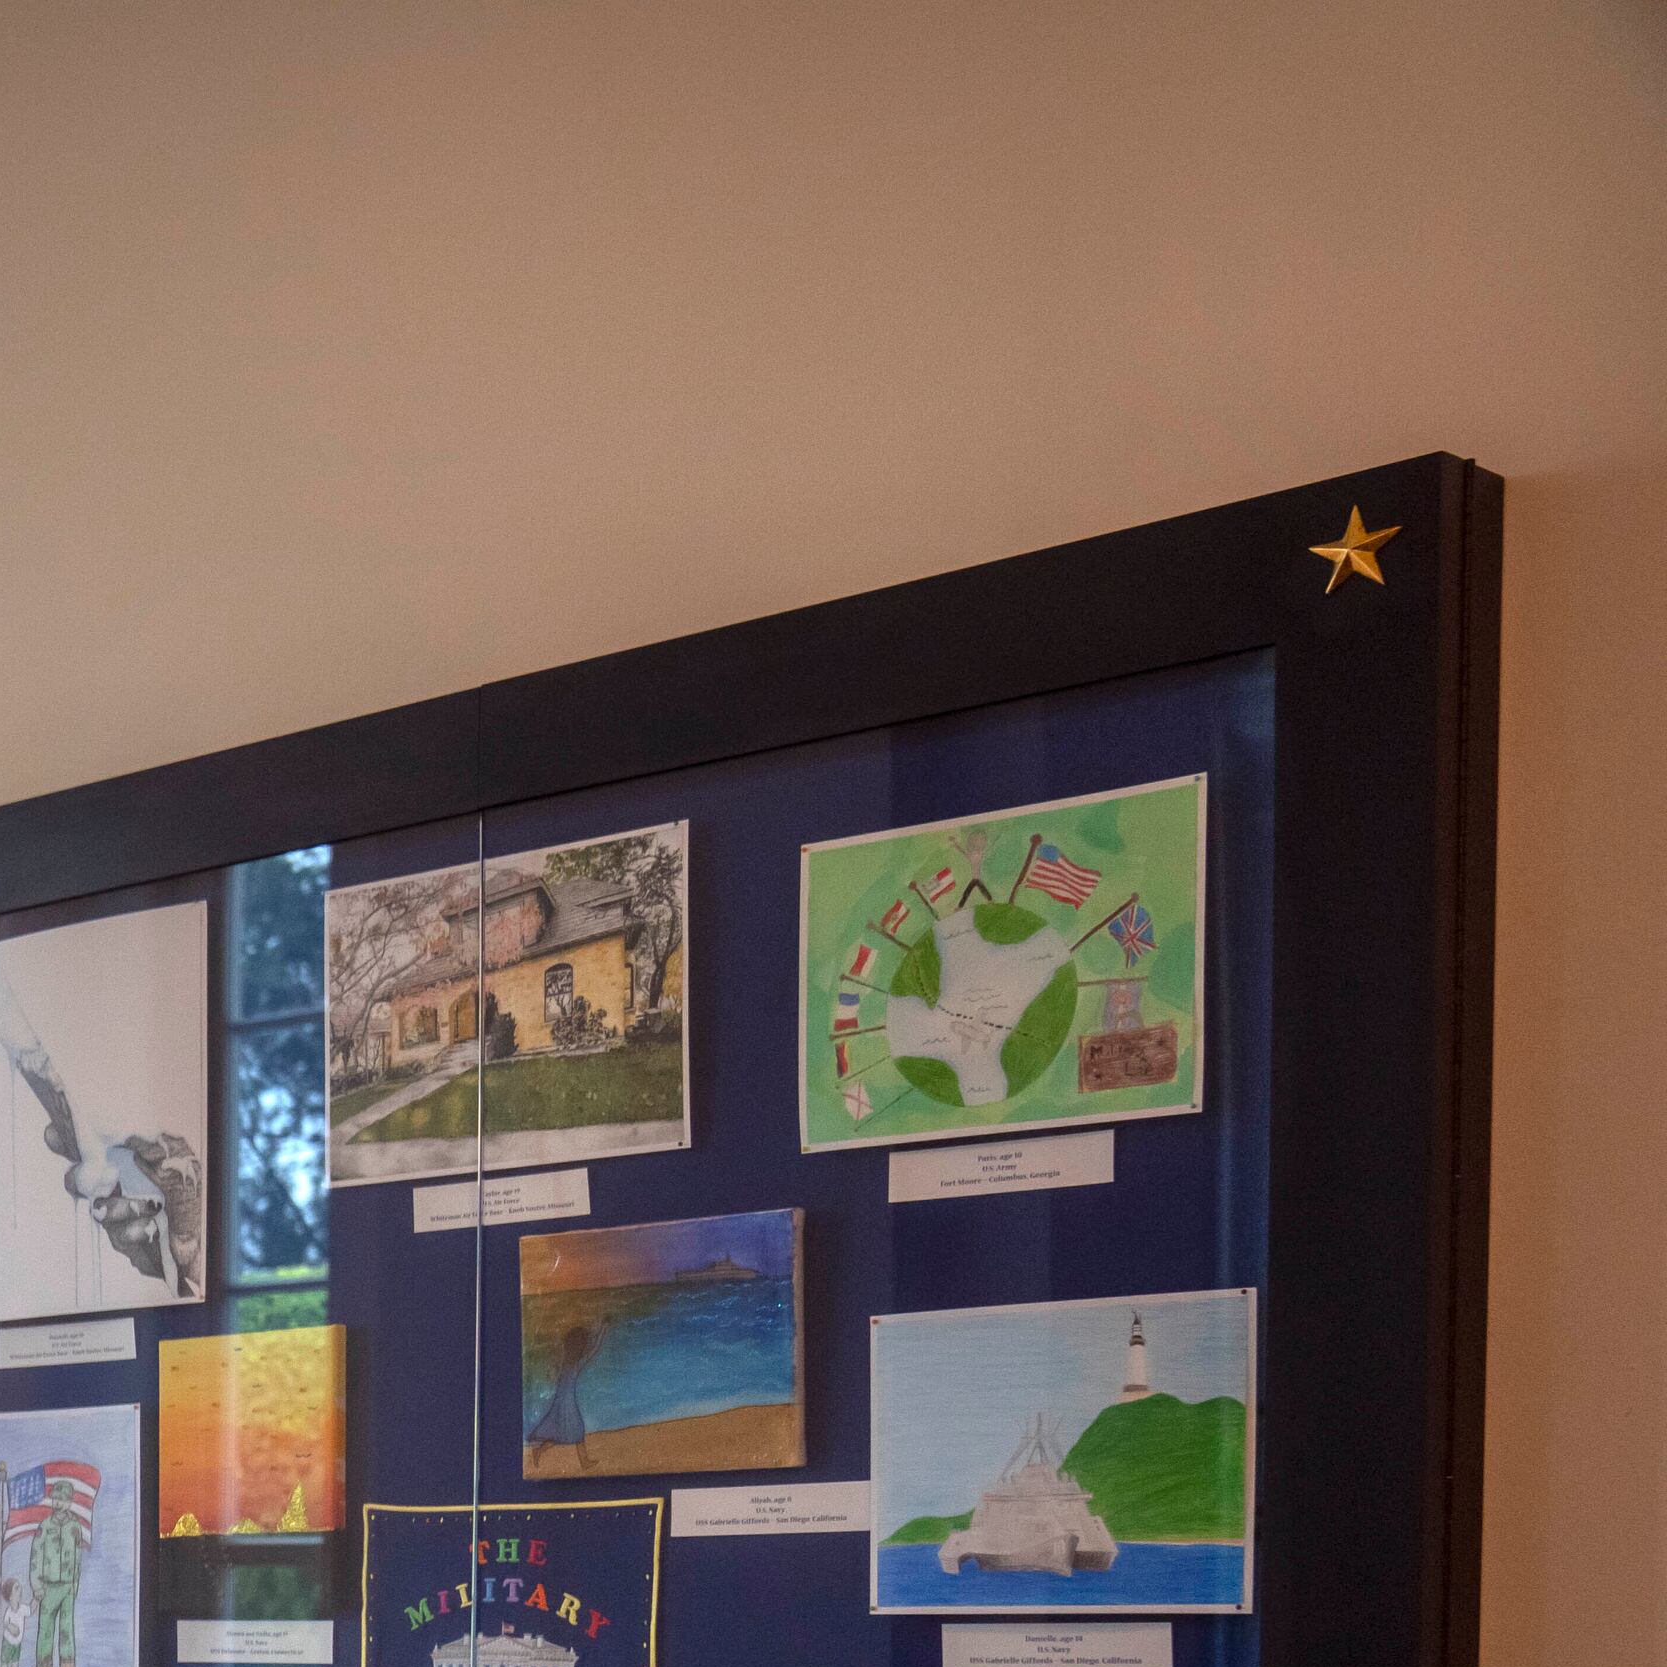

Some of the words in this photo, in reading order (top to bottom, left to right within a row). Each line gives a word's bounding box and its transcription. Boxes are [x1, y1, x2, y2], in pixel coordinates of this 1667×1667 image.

[958, 1178, 982, 1186] Moore
[1030, 1170, 1061, 1179] Georgia
[812, 1515, 847, 1523] California
[469, 1538, 548, 1566] THE
[404, 1578, 612, 1640] MILITARY
[985, 1657, 1019, 1665] Gabrielle
[1021, 1657, 1053, 1665] Giffords
[1060, 1657, 1075, 1665] San
[1102, 1656, 1142, 1665] California
